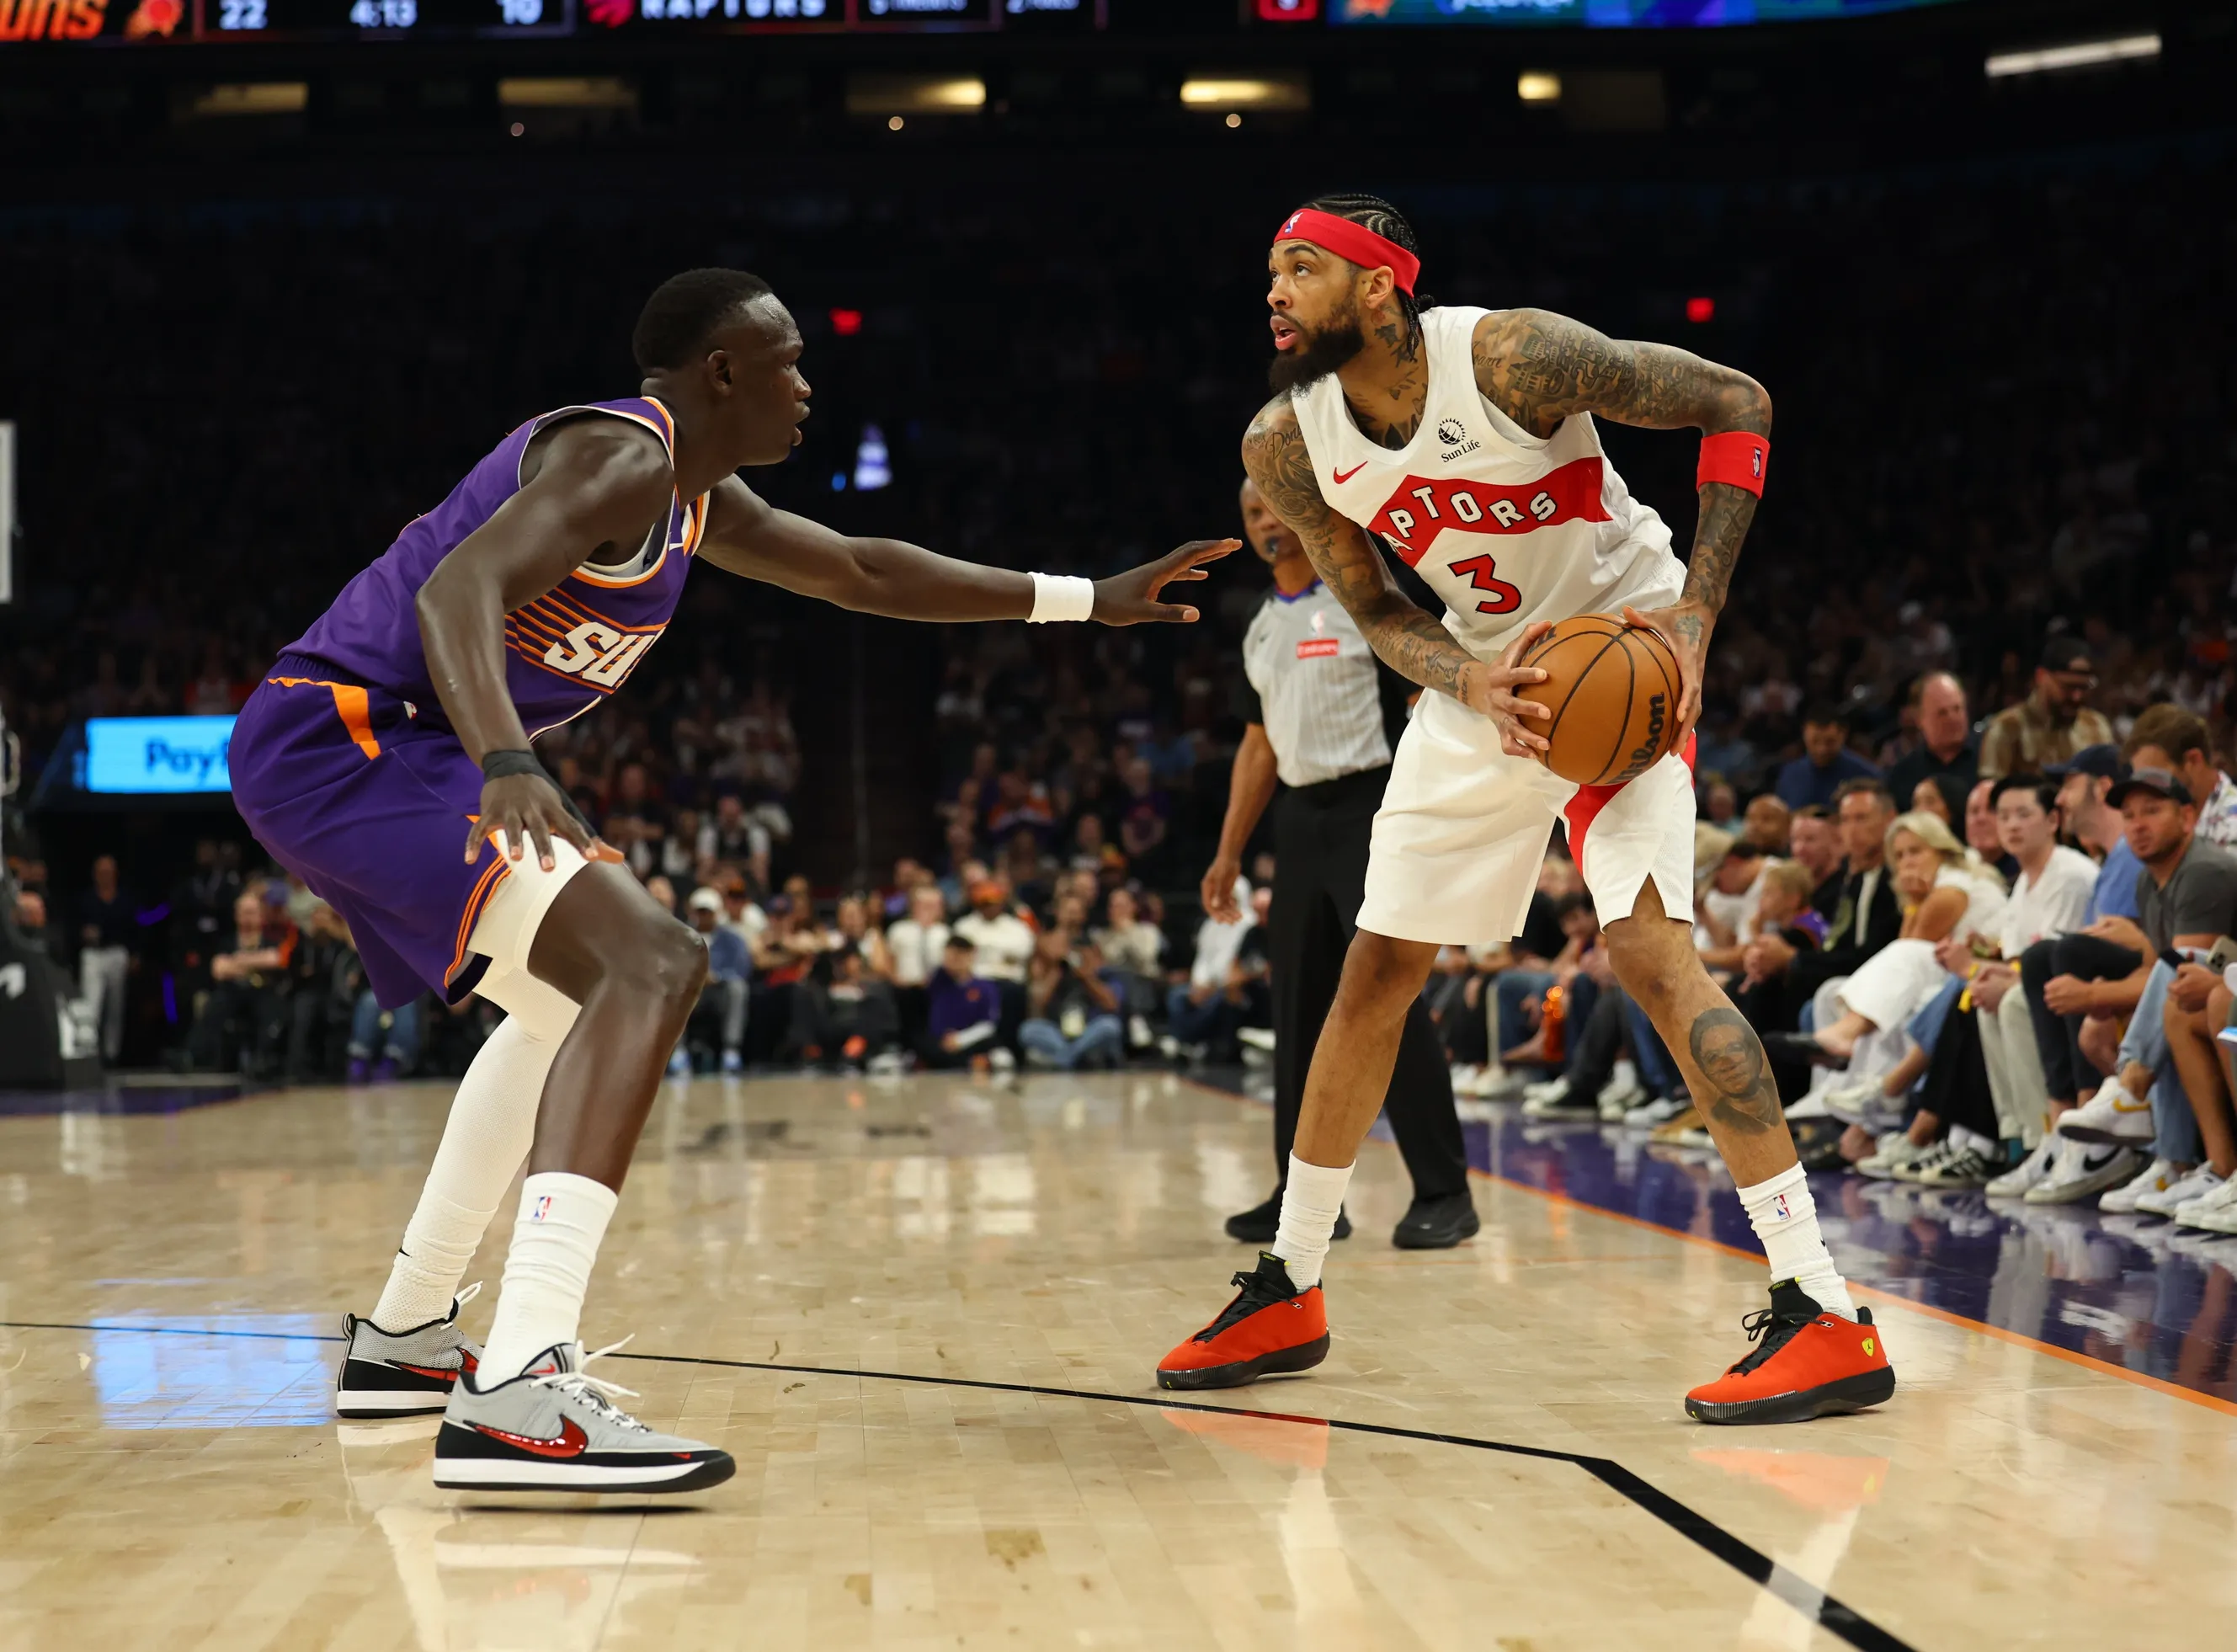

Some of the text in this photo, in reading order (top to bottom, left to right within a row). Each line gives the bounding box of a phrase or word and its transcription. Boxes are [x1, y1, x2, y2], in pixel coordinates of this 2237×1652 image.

[1441, 440, 1481, 463] Sun Life
[1380, 486, 1557, 557] APTORS
[1447, 553, 1522, 615] 3
[544, 621, 666, 688] SU
